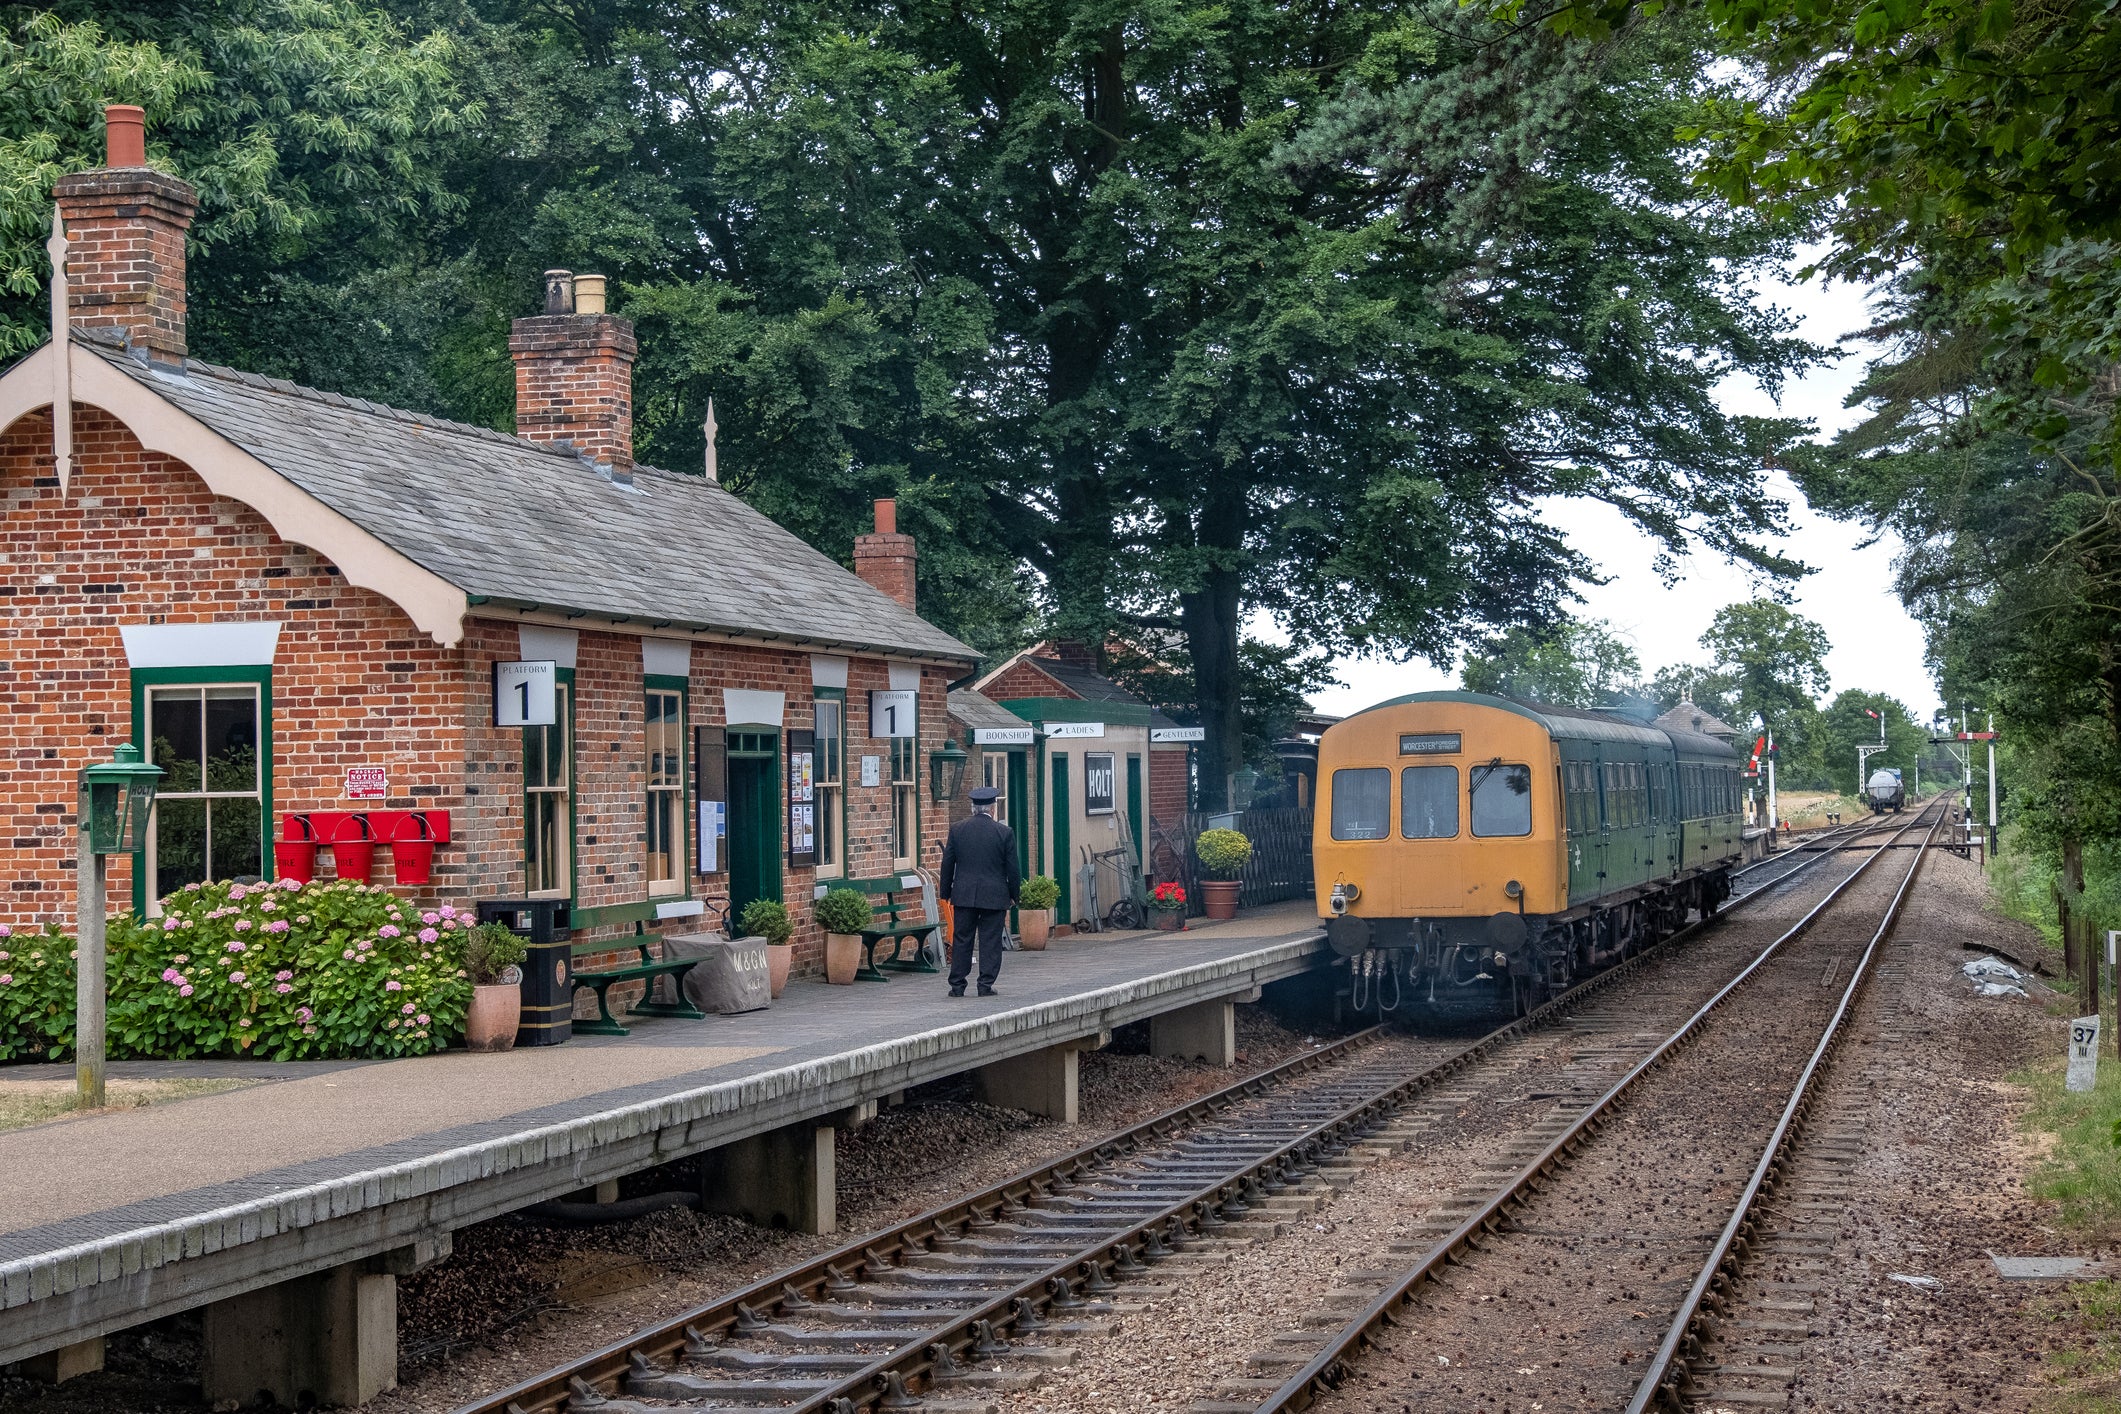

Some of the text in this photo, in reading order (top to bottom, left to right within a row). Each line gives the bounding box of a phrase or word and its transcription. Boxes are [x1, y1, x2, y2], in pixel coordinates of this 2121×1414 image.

[502, 665, 547, 674] PLATFORM
[514, 680, 528, 721] 1
[885, 704, 895, 734] 1
[986, 730, 1030, 740] BOOKSHOP
[1065, 726, 1095, 734] LADIES
[1162, 730, 1203, 738] GENTLEMEN
[1403, 741, 1435, 750] WORCESTER
[1088, 769, 1111, 798] HOLT
[131, 784, 152, 796] HOLT
[278, 858, 296, 867] FIRE
[336, 858, 354, 867] FIRE
[395, 858, 417, 868] FIRE
[733, 949, 767, 972] M&GN
[2074, 1028, 2095, 1044] 37
